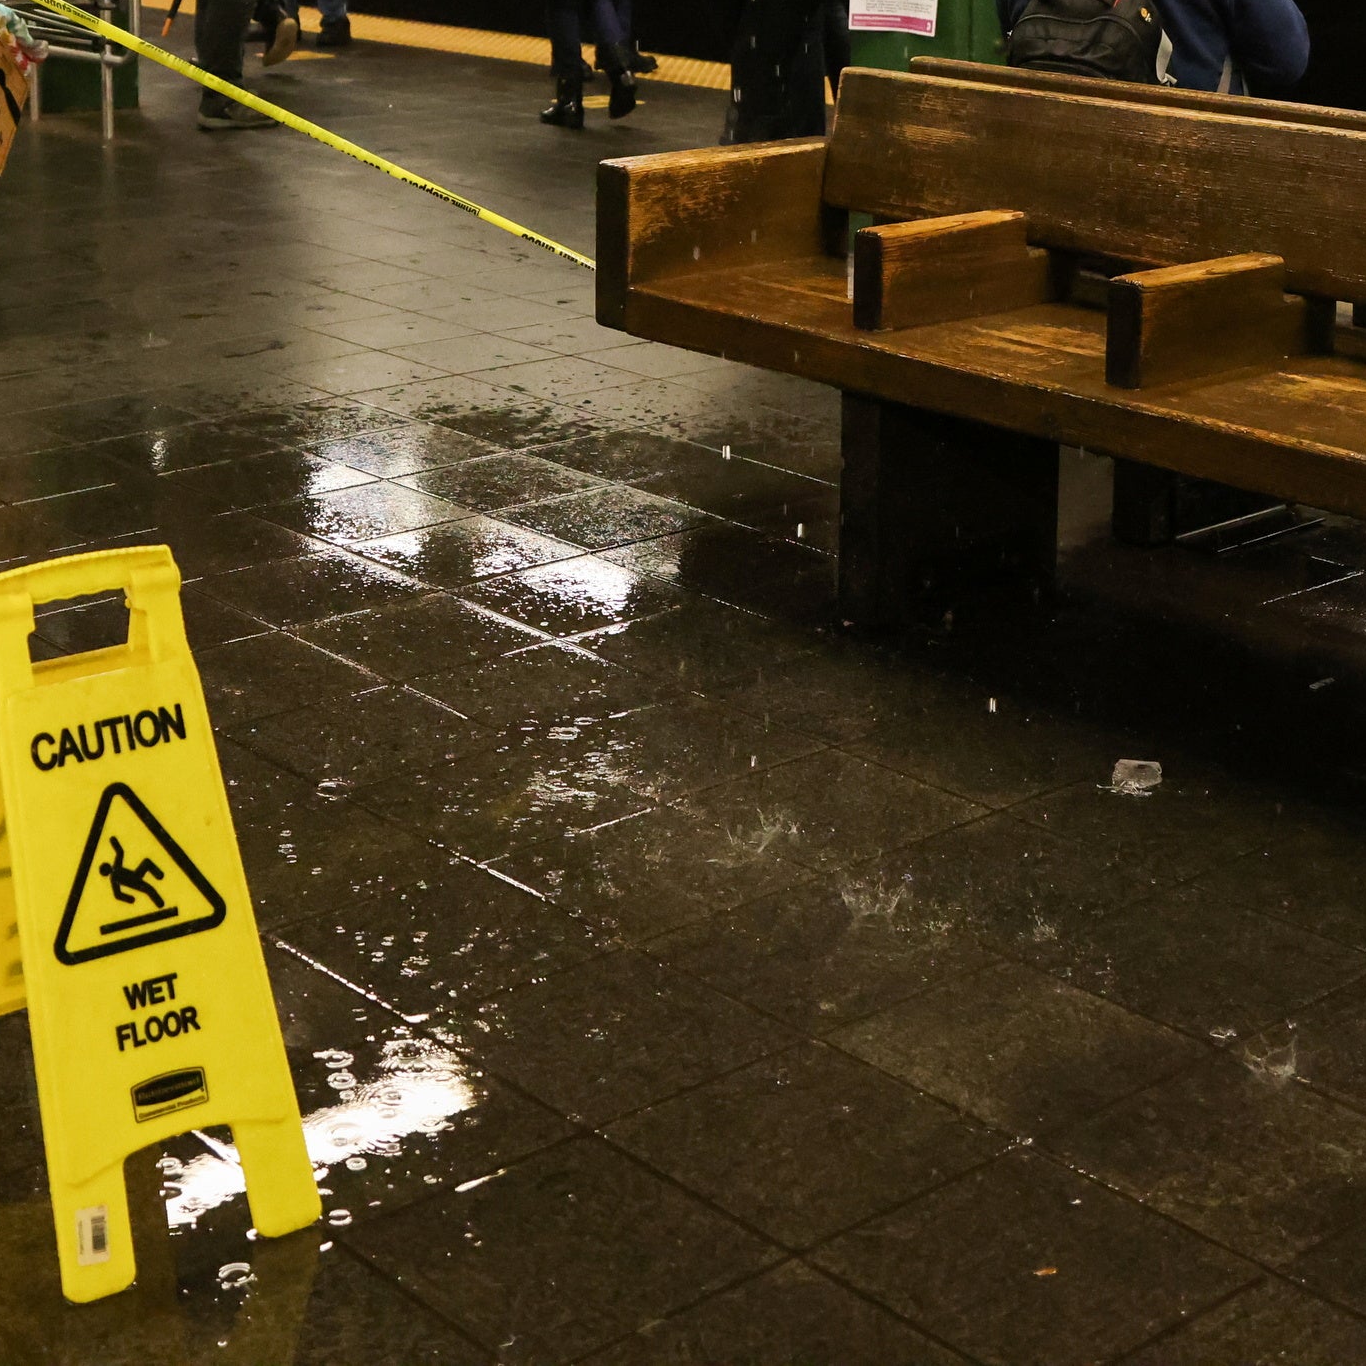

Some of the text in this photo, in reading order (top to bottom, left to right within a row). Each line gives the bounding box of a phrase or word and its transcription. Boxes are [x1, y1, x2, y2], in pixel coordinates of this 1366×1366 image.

[31, 703, 187, 772] CAUTION
[123, 973, 179, 1012] WET
[116, 1004, 201, 1052] FLOOR
